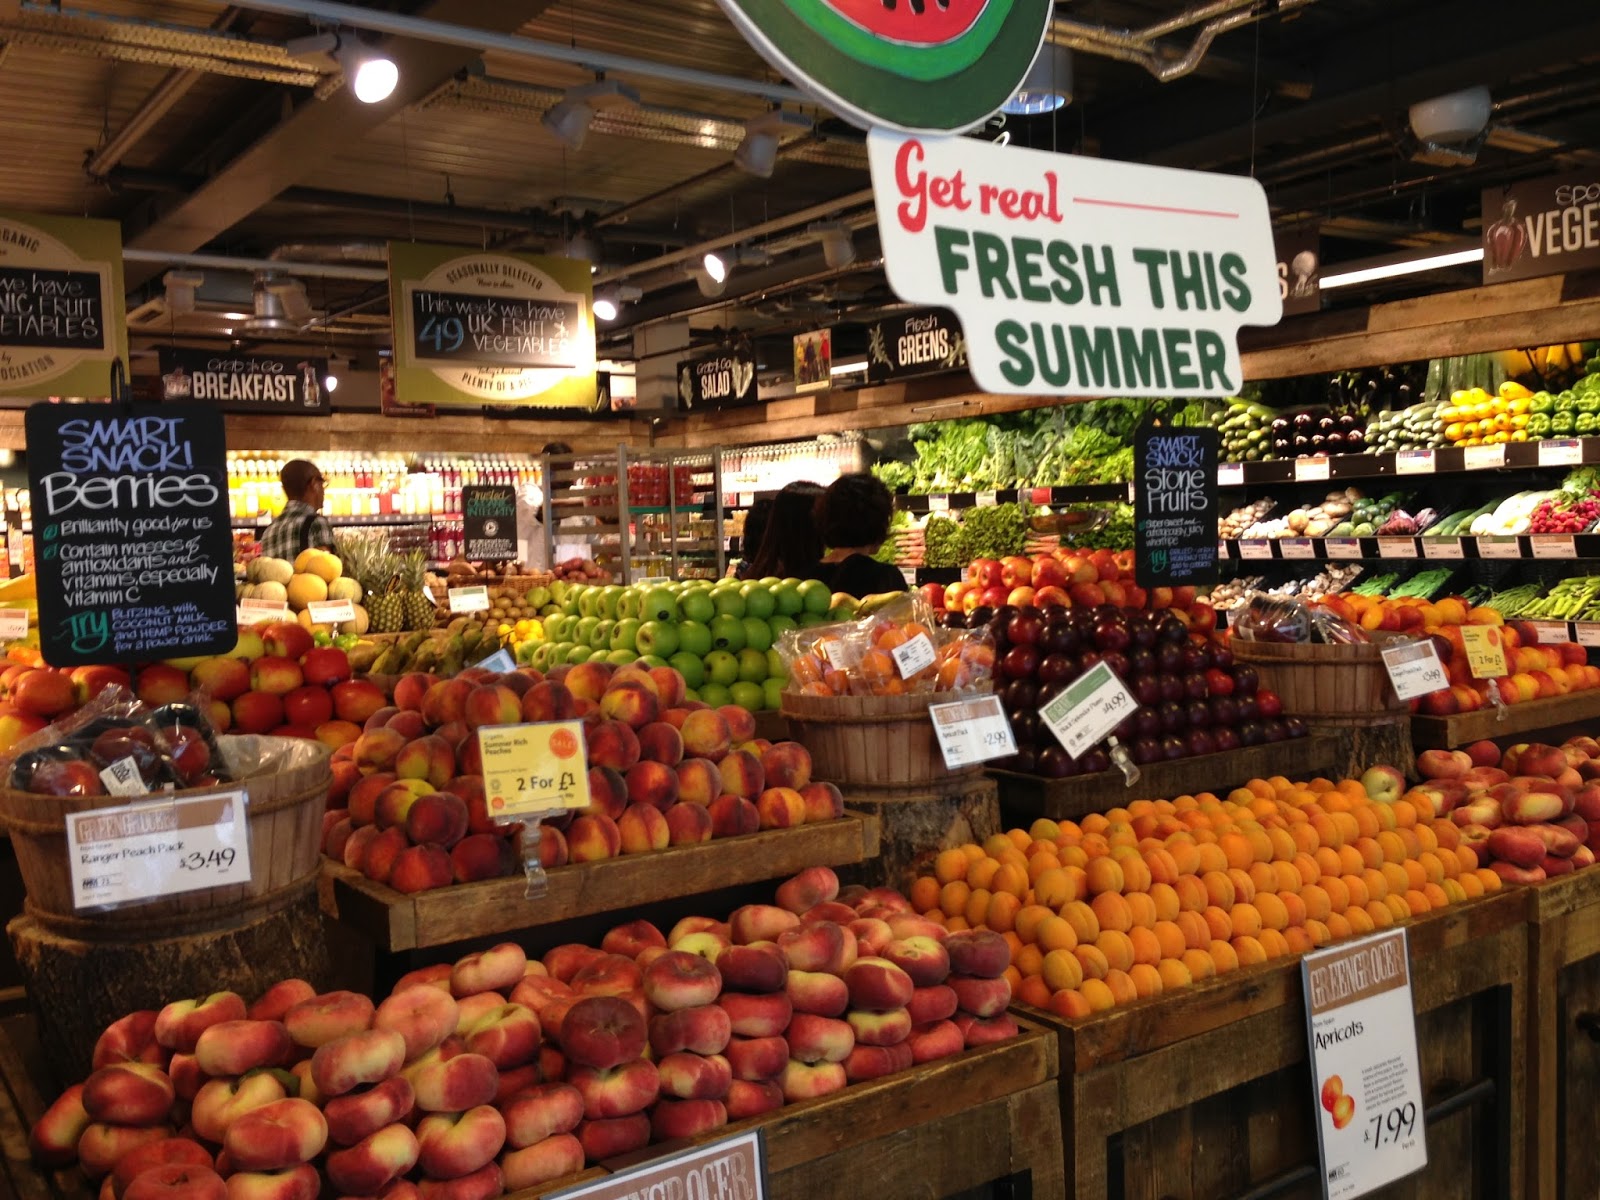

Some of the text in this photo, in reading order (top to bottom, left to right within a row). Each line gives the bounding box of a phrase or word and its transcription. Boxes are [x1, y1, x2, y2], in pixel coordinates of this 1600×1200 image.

[895, 139, 1064, 233] Get real
[0, 229, 40, 253] GANIC
[446, 262, 544, 292] SEASONALLY SELECTED
[934, 225, 1121, 307] FRESH
[1133, 247, 1252, 313] THIS
[33, 273, 84, 296] have
[39, 295, 96, 318] FRUIT
[418, 293, 566, 320] This week we have
[419, 316, 465, 351] 49
[468, 314, 494, 334] UK
[502, 317, 544, 336] FRUIT
[905, 314, 938, 333] Fresh
[472, 334, 570, 355] VEGETABLES
[898, 327, 950, 366] GREENS
[995, 319, 1235, 391] SUMMER
[261, 360, 284, 374] Go
[720, 357, 732, 371] Go
[193, 371, 297, 401] BREAKFAST
[461, 372, 493, 391] PLENTY
[496, 380, 505, 391] OF
[701, 370, 730, 400] SALAD
[58, 416, 185, 447] SMART
[1147, 435, 1200, 451] SMART
[61, 441, 194, 473] SNACK!
[1146, 447, 1204, 469] SNACK!
[1144, 467, 1206, 492] Stone
[40, 471, 219, 515] Berries
[1147, 487, 1208, 514] Fruits
[61, 516, 213, 537] Brilliantly good for us
[1187, 525, 1204, 537] juicy
[59, 535, 202, 561] Contain masses of
[61, 553, 209, 576] antioxidants and
[1148, 549, 1168, 573] Try
[139, 563, 219, 587] especially
[64, 584, 142, 607] vitamin C
[173, 602, 197, 614] with
[58, 610, 109, 654] Try
[112, 612, 209, 630] COCONUT MILK
[114, 620, 228, 642] and HEMP POWDER
[114, 633, 215, 655] for a power drink
[517, 772, 576, 791] 2 For £1
[123, 845, 156, 858] Peach
[1310, 938, 1405, 1009] GREENGROCER
[1315, 1021, 1364, 1050] Apricots
